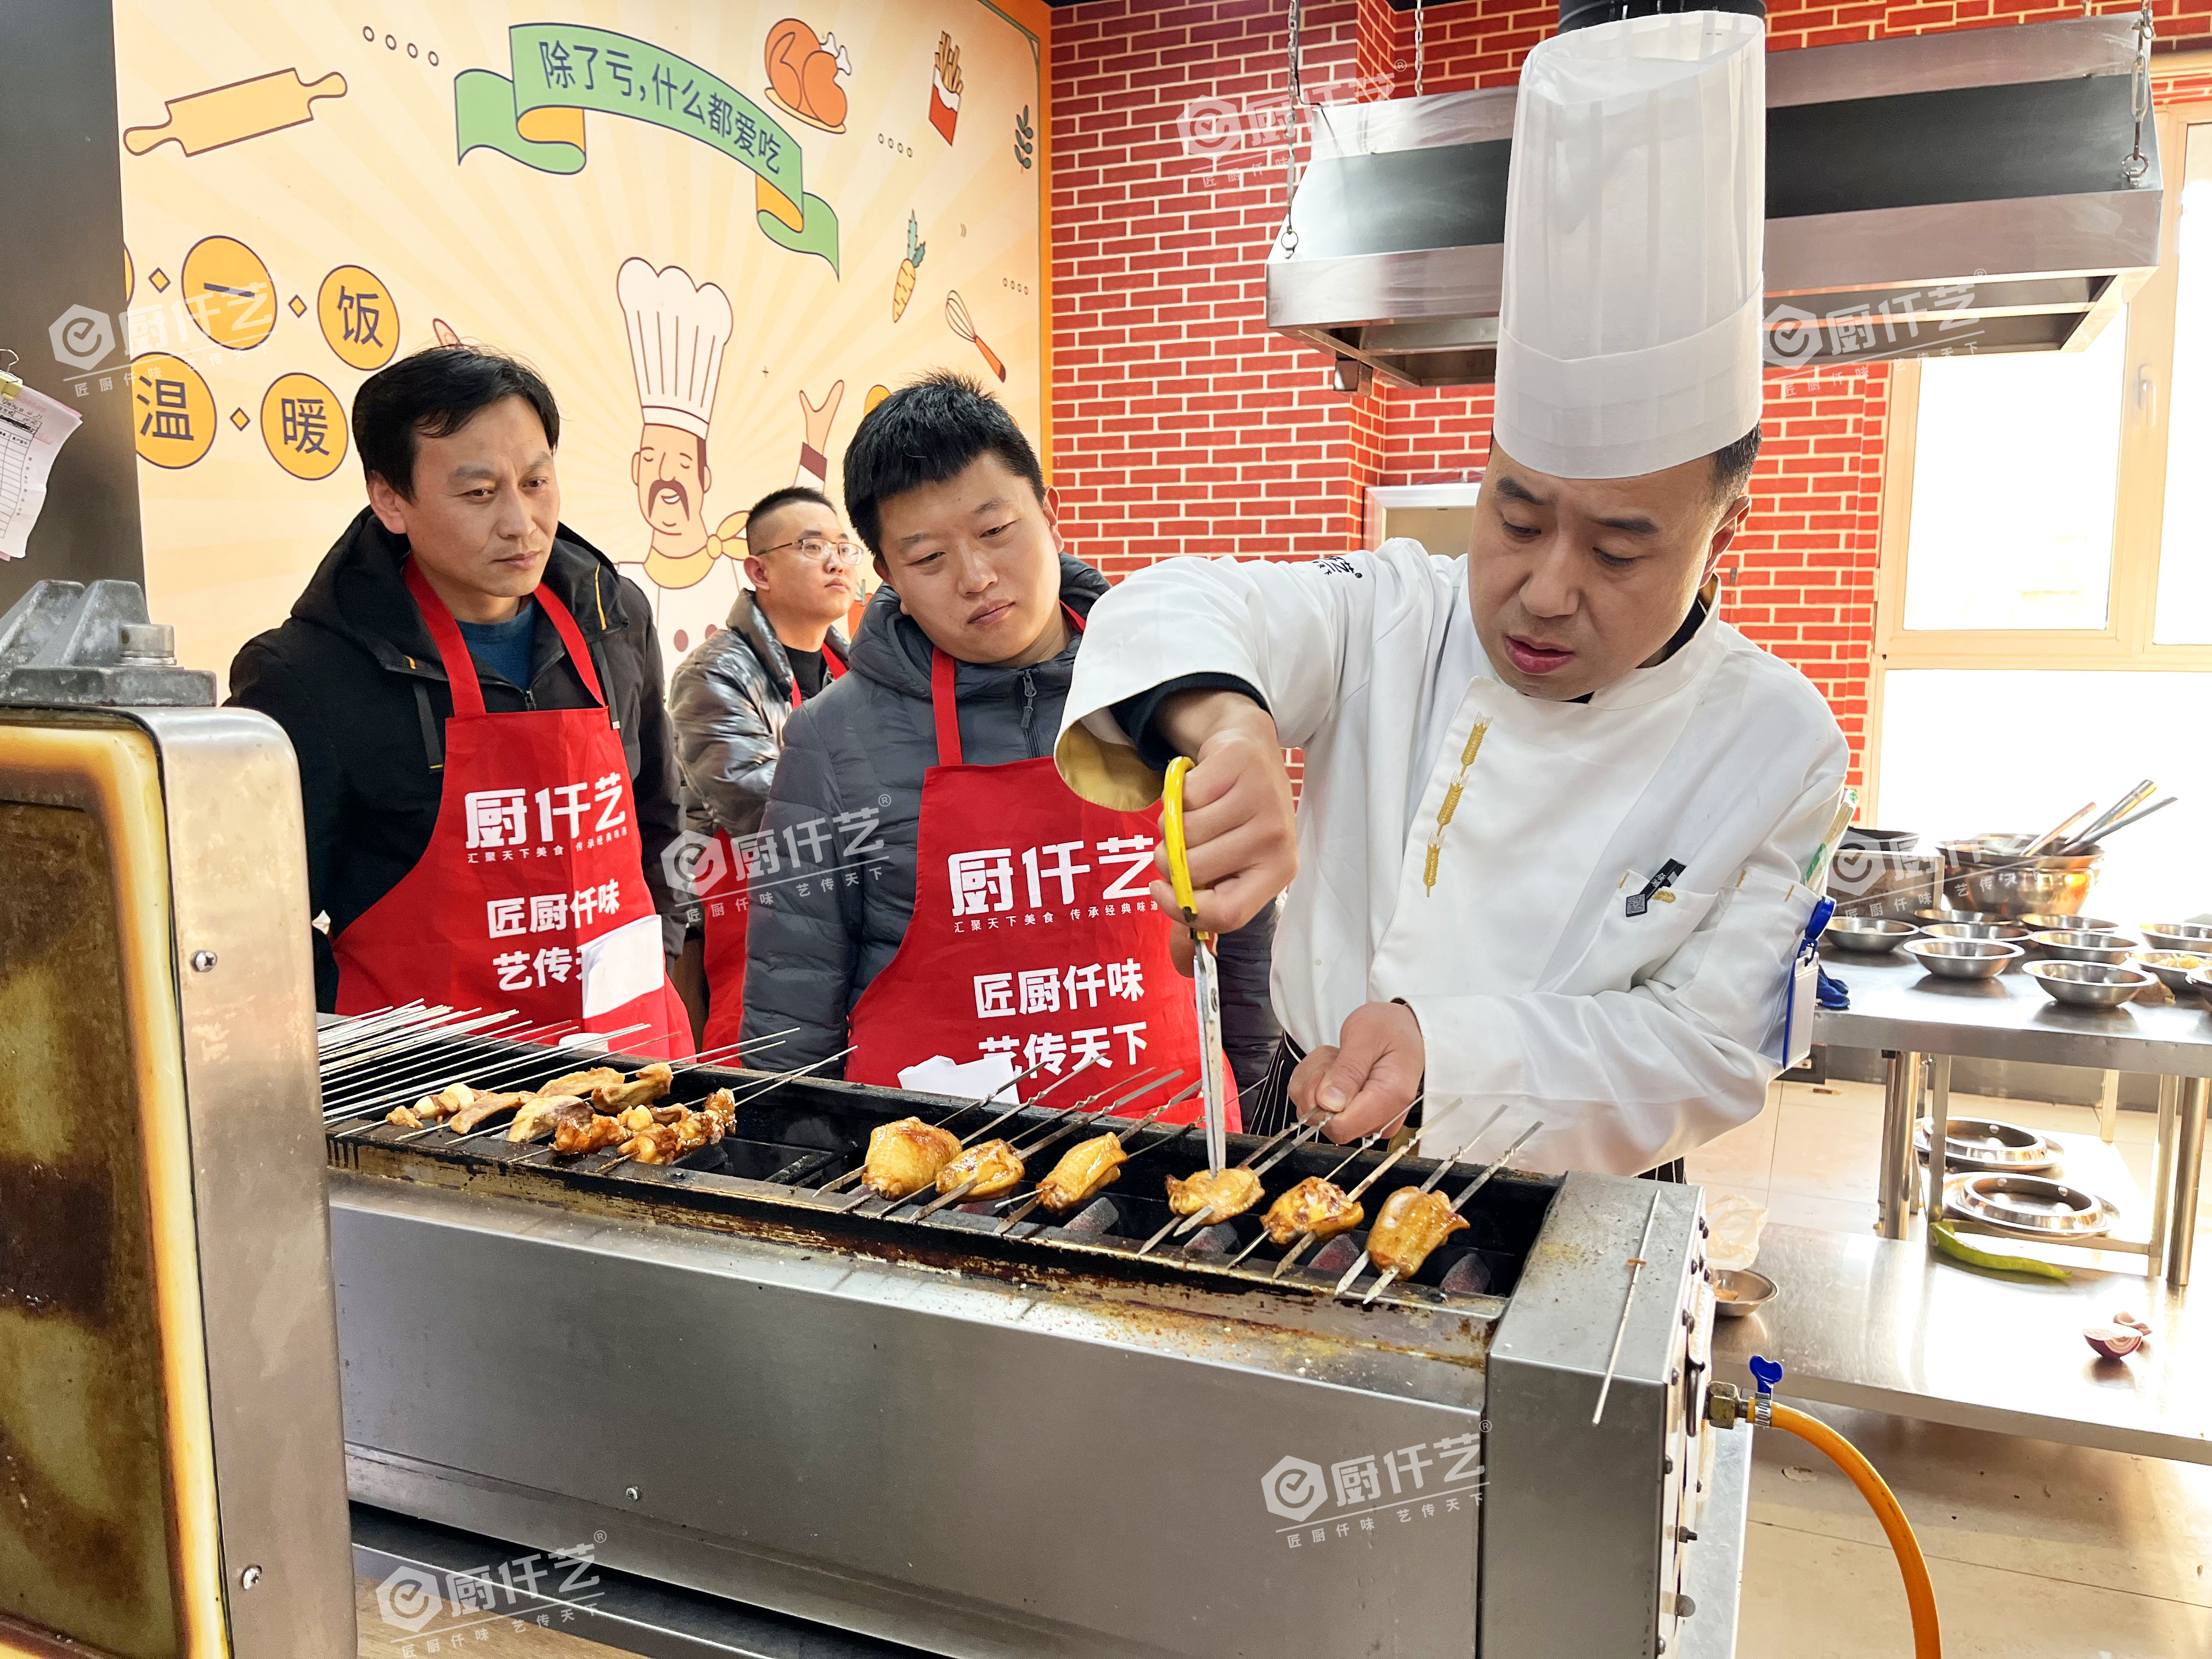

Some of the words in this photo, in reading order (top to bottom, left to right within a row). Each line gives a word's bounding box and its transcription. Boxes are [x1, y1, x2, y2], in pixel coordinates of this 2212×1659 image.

[337, 284, 384, 349] 饭
[137, 376, 194, 441] 温
[281, 397, 330, 456] 暖
[465, 772, 625, 849] 厨仟艺
[467, 844, 564, 864] 汇聚天下美食
[947, 834, 1154, 917] 厨仟艺
[487, 878, 620, 939] 匠厨仟味
[954, 913, 1054, 934] 汇聚天下美食
[973, 957, 1145, 1019] 匠厨仟味
